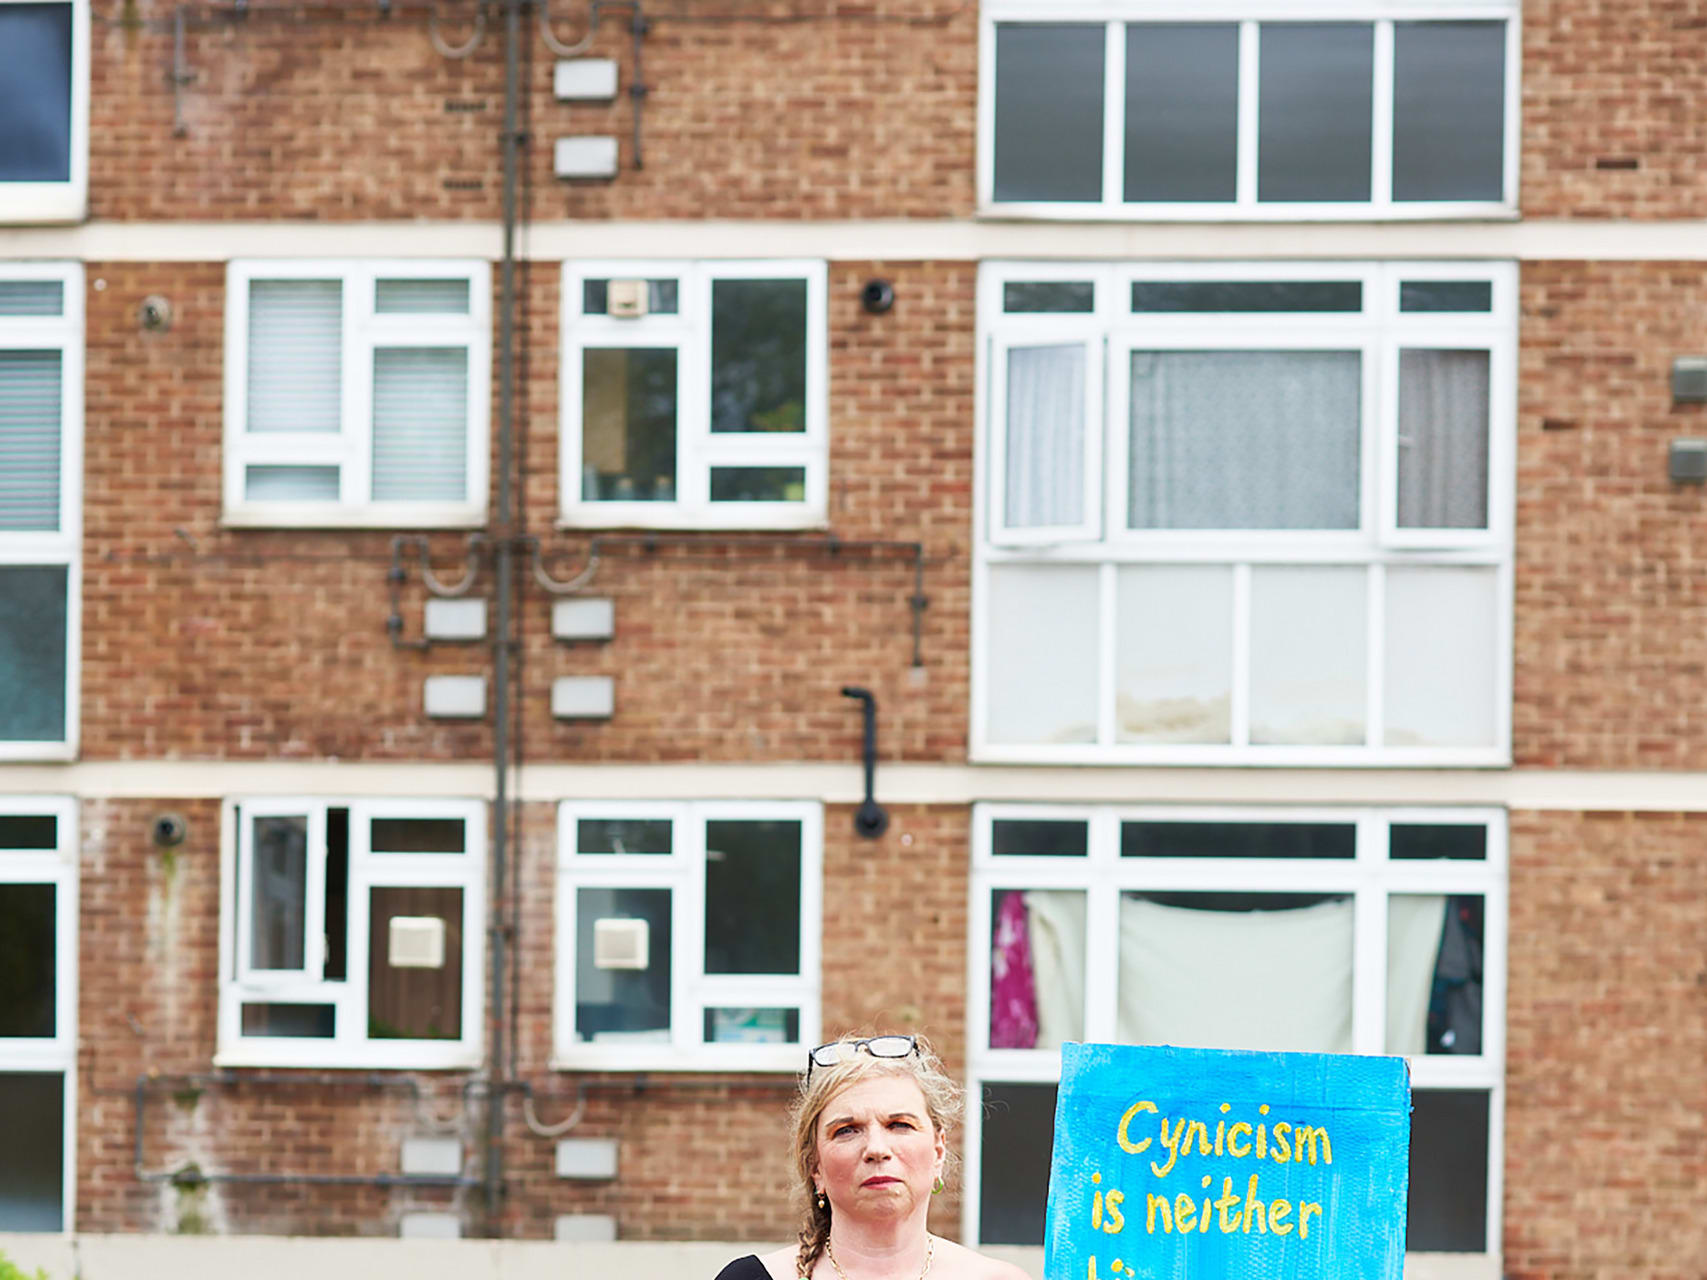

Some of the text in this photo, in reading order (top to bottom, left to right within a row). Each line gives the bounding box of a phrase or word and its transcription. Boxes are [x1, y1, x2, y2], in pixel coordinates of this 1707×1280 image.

[1117, 1100, 1334, 1179] Cynicism
[1091, 1172, 1323, 1240] is neither
